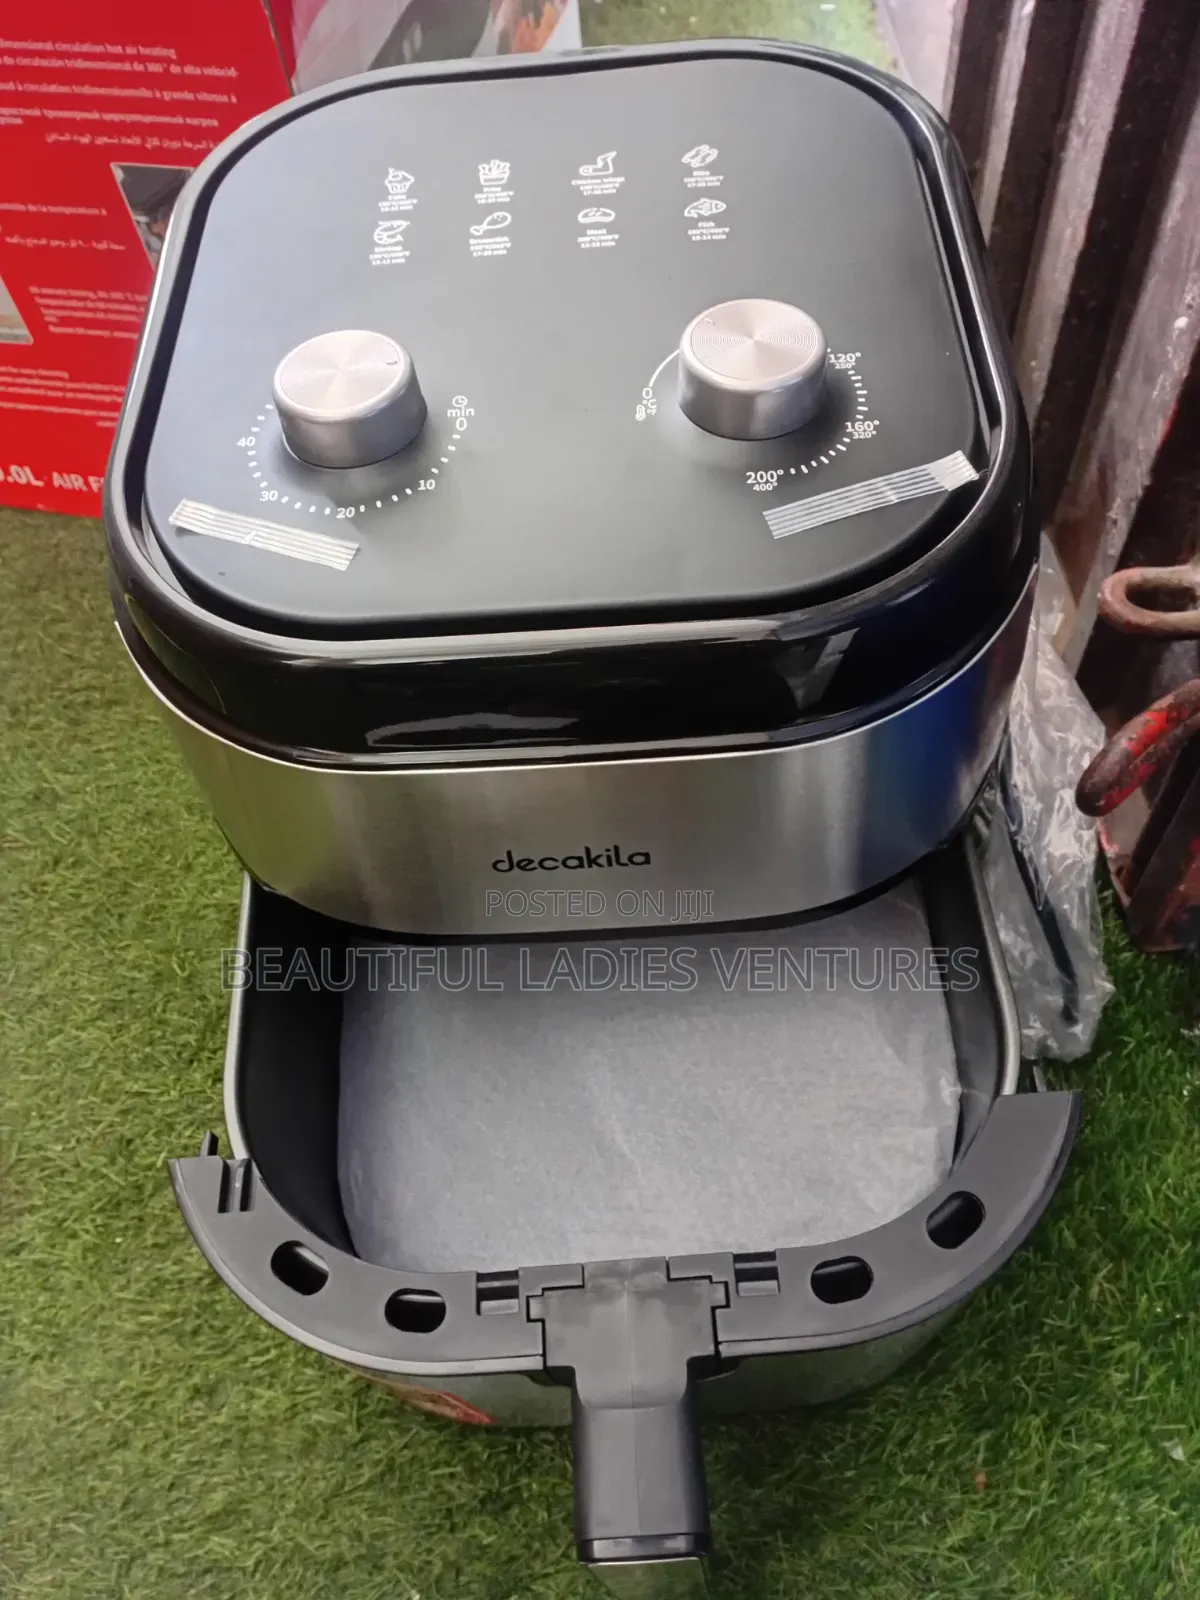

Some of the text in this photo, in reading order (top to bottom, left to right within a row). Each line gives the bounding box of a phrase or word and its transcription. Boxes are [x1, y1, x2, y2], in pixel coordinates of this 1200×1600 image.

[829, 352, 861, 363] 120°
[447, 406, 475, 418] min
[845, 420, 880, 432] 160°
[237, 436, 256, 447] 40
[52, 471, 88, 492] AIR
[745, 469, 784, 484] 200°
[417, 479, 436, 491] 10
[753, 482, 778, 491] 400°
[260, 490, 279, 502] 30
[336, 507, 356, 519] 20
